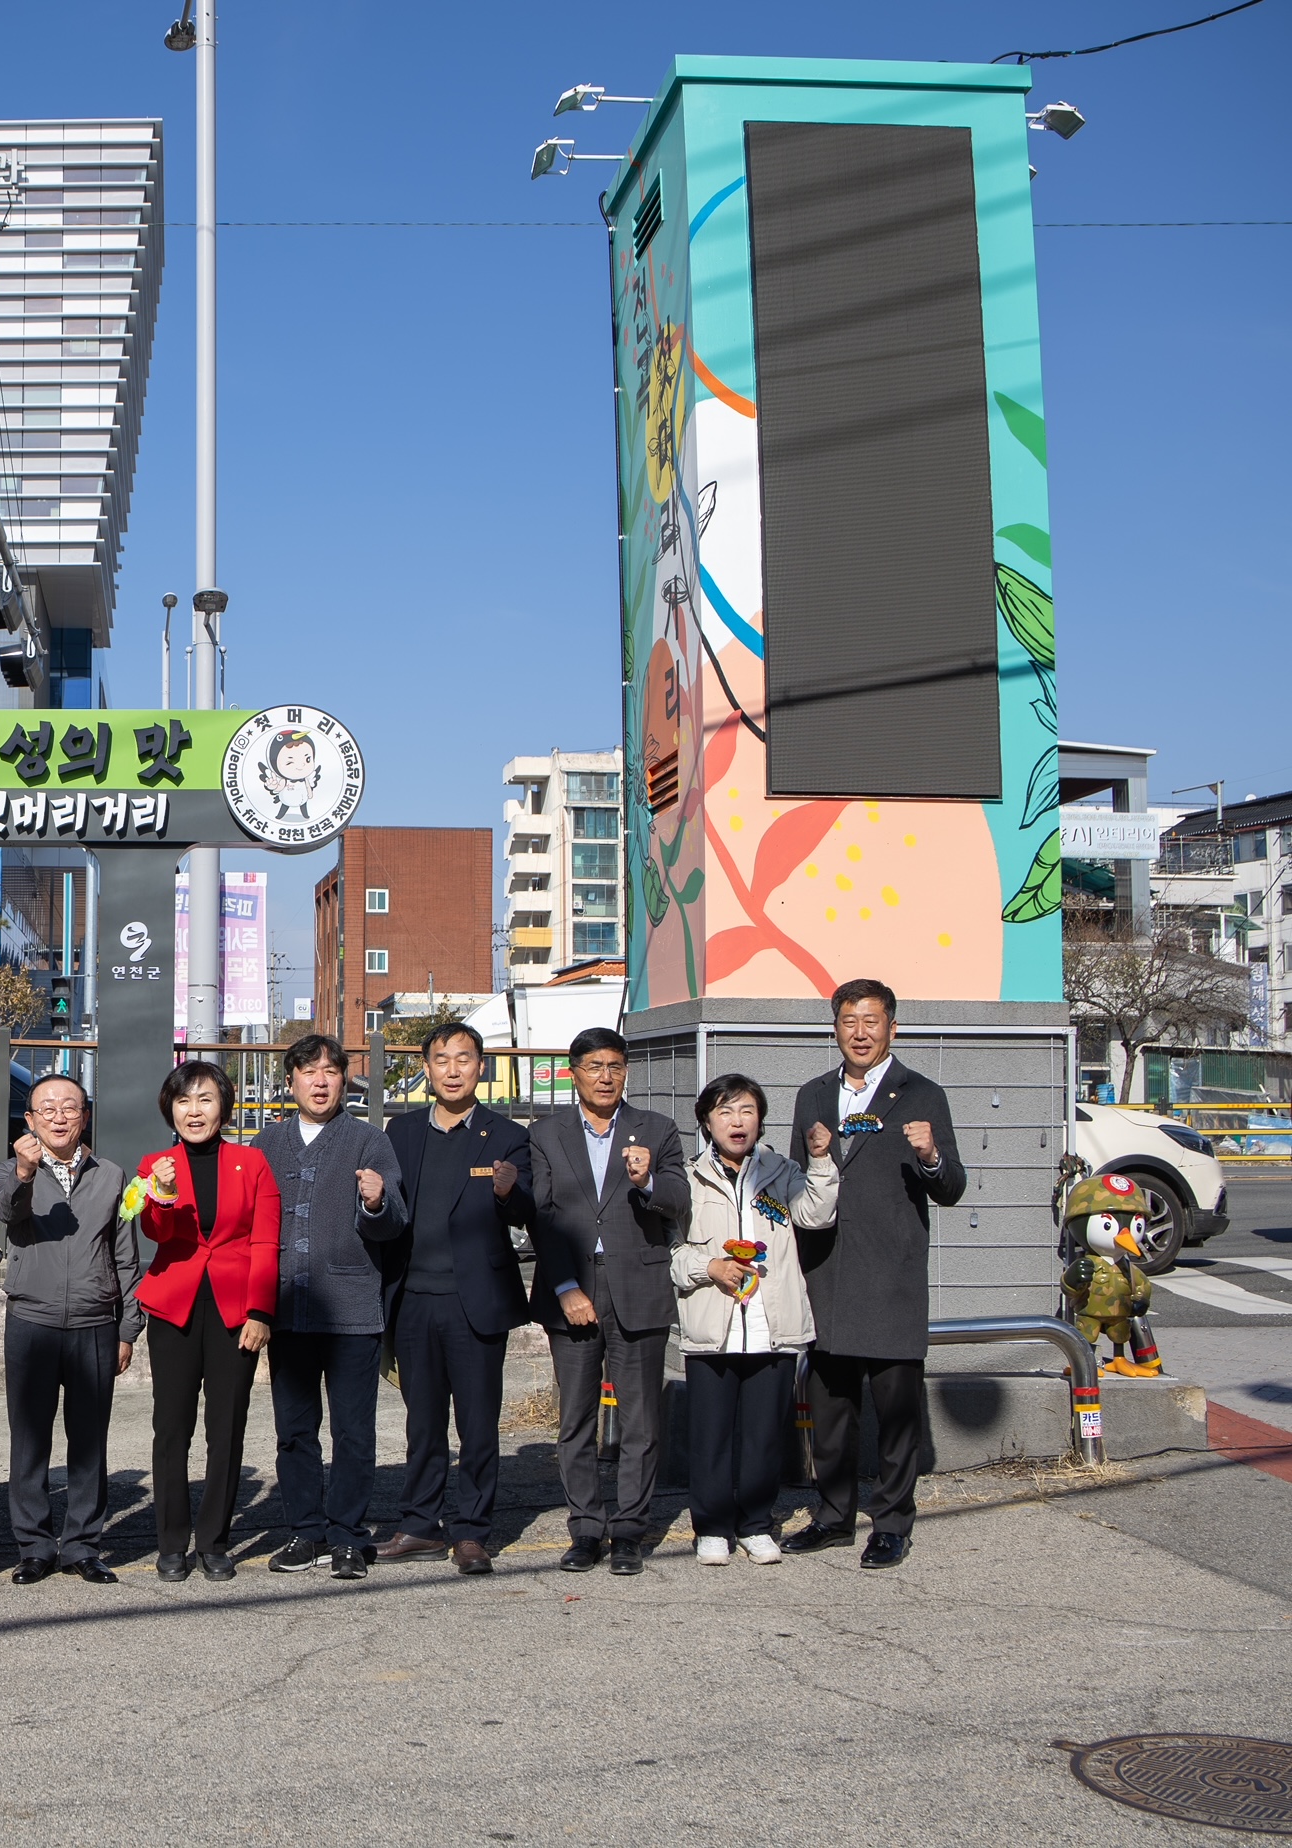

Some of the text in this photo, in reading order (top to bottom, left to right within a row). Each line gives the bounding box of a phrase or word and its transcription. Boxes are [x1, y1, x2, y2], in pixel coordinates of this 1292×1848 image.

[133, 719, 194, 788] 맛
[278, 740, 360, 841] 연천 전곡 첫머리 상인회
[1096, 827, 1156, 842] 인테리어
[111, 966, 161, 980] 연천군
